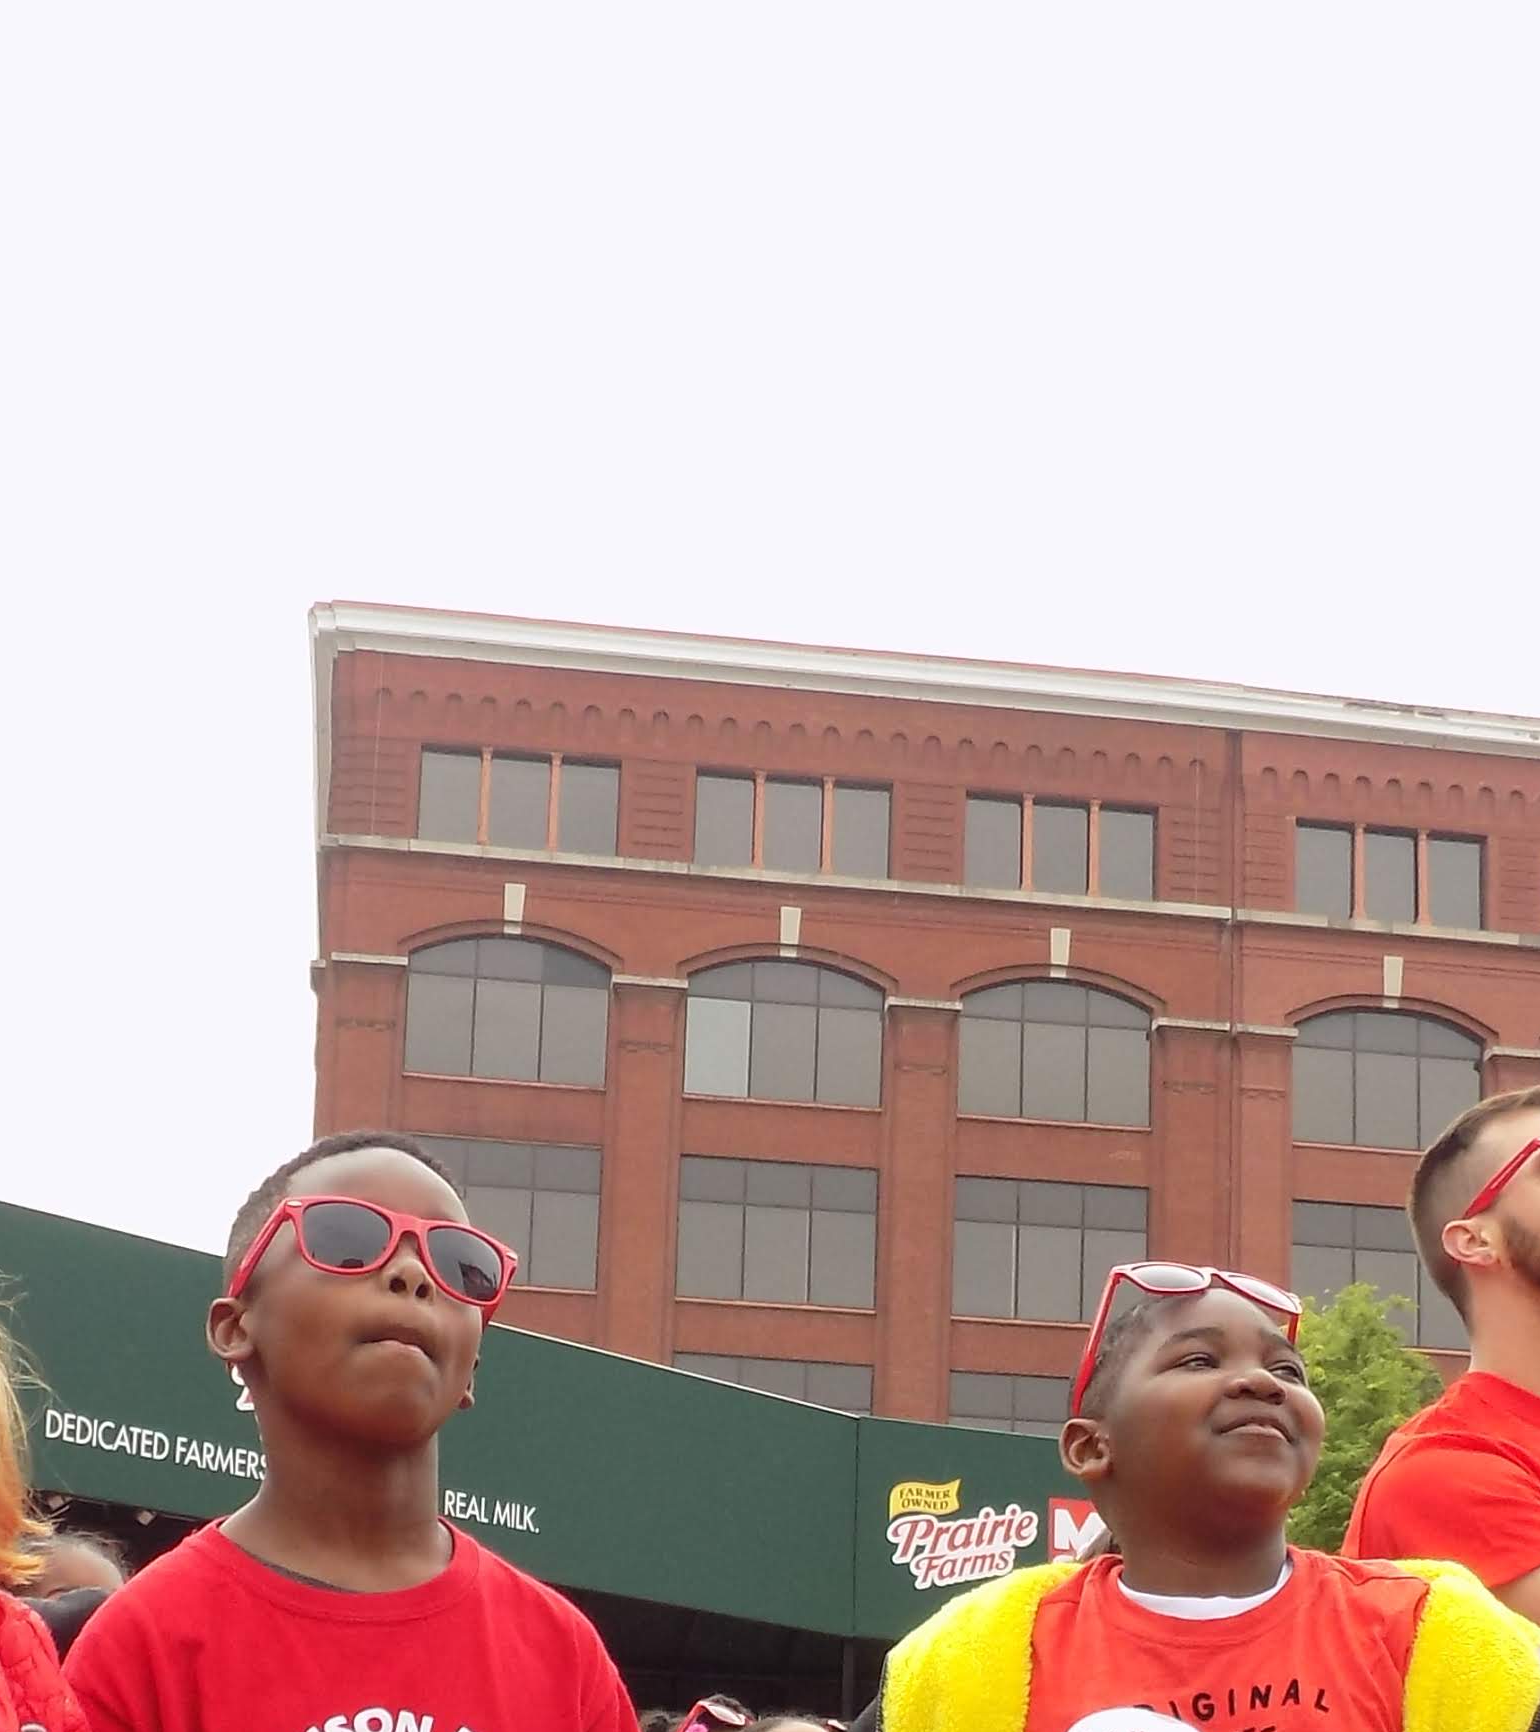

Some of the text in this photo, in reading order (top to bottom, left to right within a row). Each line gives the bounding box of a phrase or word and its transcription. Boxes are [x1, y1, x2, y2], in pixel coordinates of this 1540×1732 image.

[44, 1409, 170, 1461] DEDICATED
[444, 1489, 540, 1534] REAL MILK.
[899, 1487, 951, 1500] FARMER
[901, 1497, 949, 1511] OWNED
[891, 1508, 1036, 1559] Prairie
[914, 1550, 1012, 1584] Farms
[1132, 1678, 1330, 1722] IGINAL
